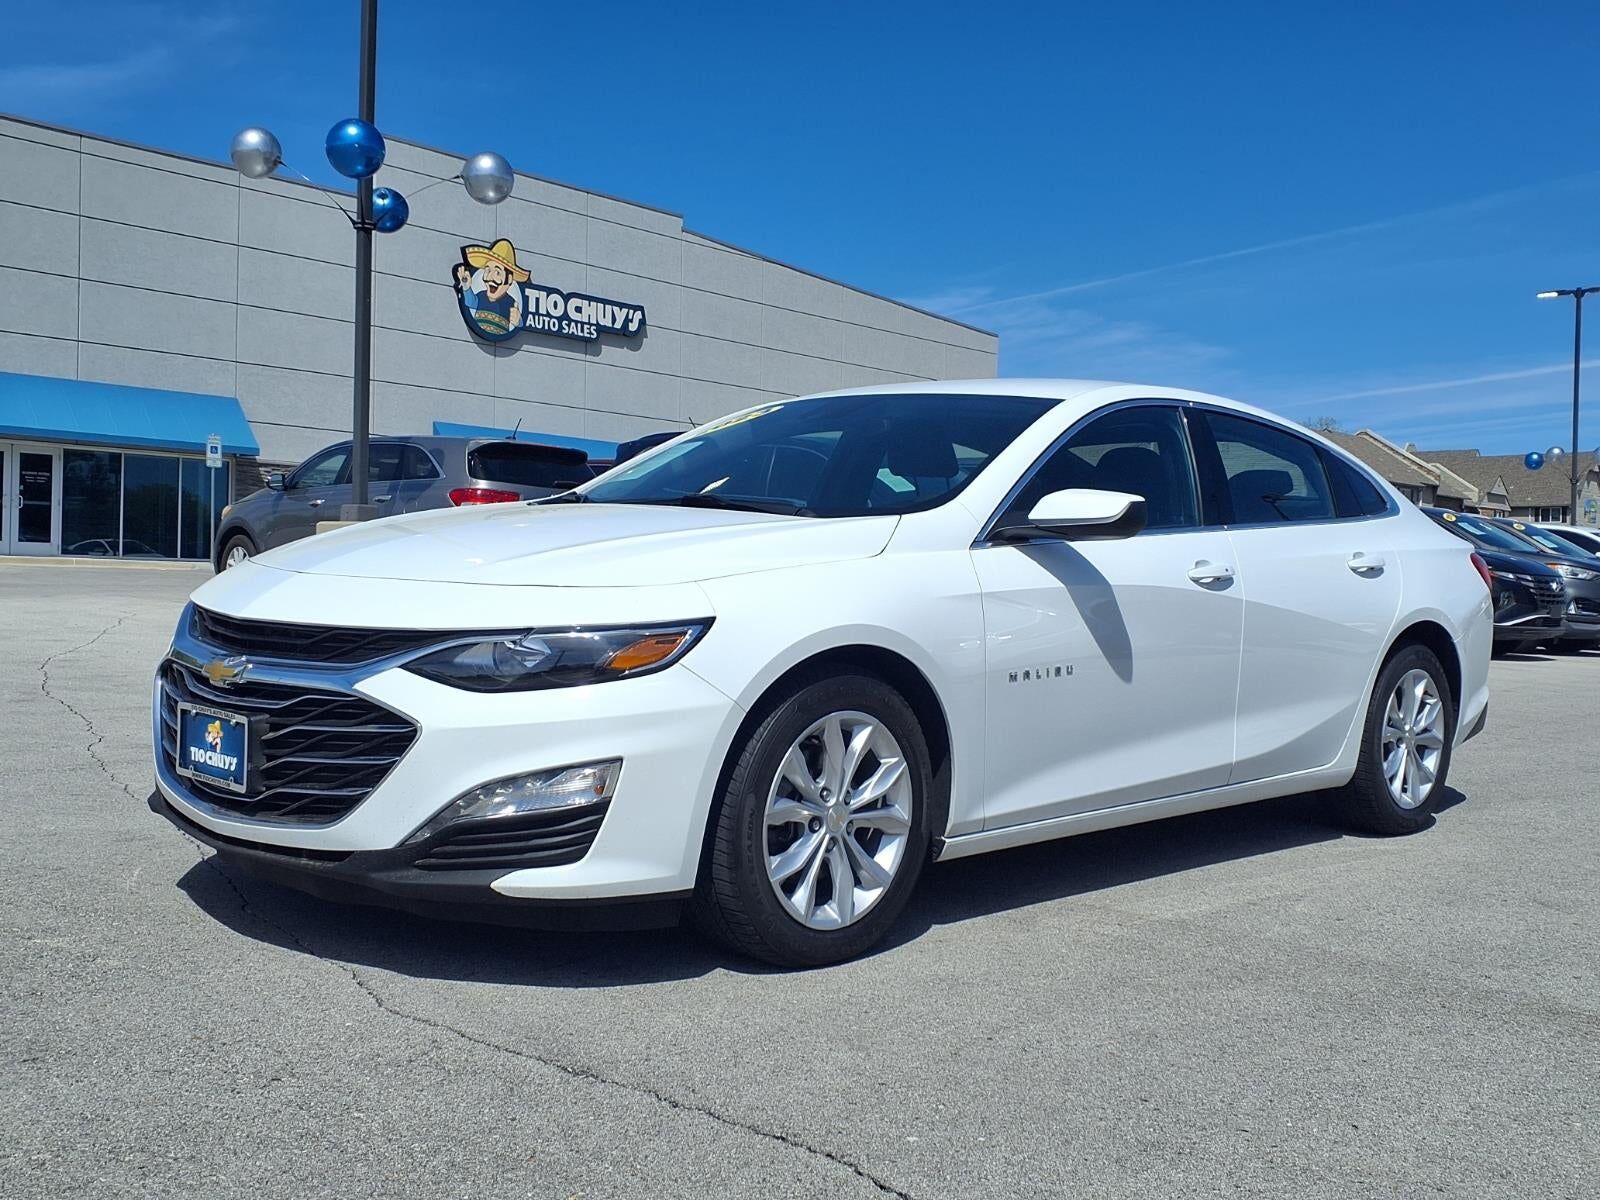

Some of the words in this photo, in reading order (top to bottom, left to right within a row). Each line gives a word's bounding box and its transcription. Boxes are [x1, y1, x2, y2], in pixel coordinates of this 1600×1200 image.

[525, 288, 565, 317] TIO
[567, 297, 642, 332] CHUY'S
[525, 314, 559, 332] AUTO
[562, 320, 598, 339] SALES
[1009, 665, 1073, 683] MALIBU
[190, 746, 206, 763] TIO
[206, 750, 238, 771] CHUY'S
